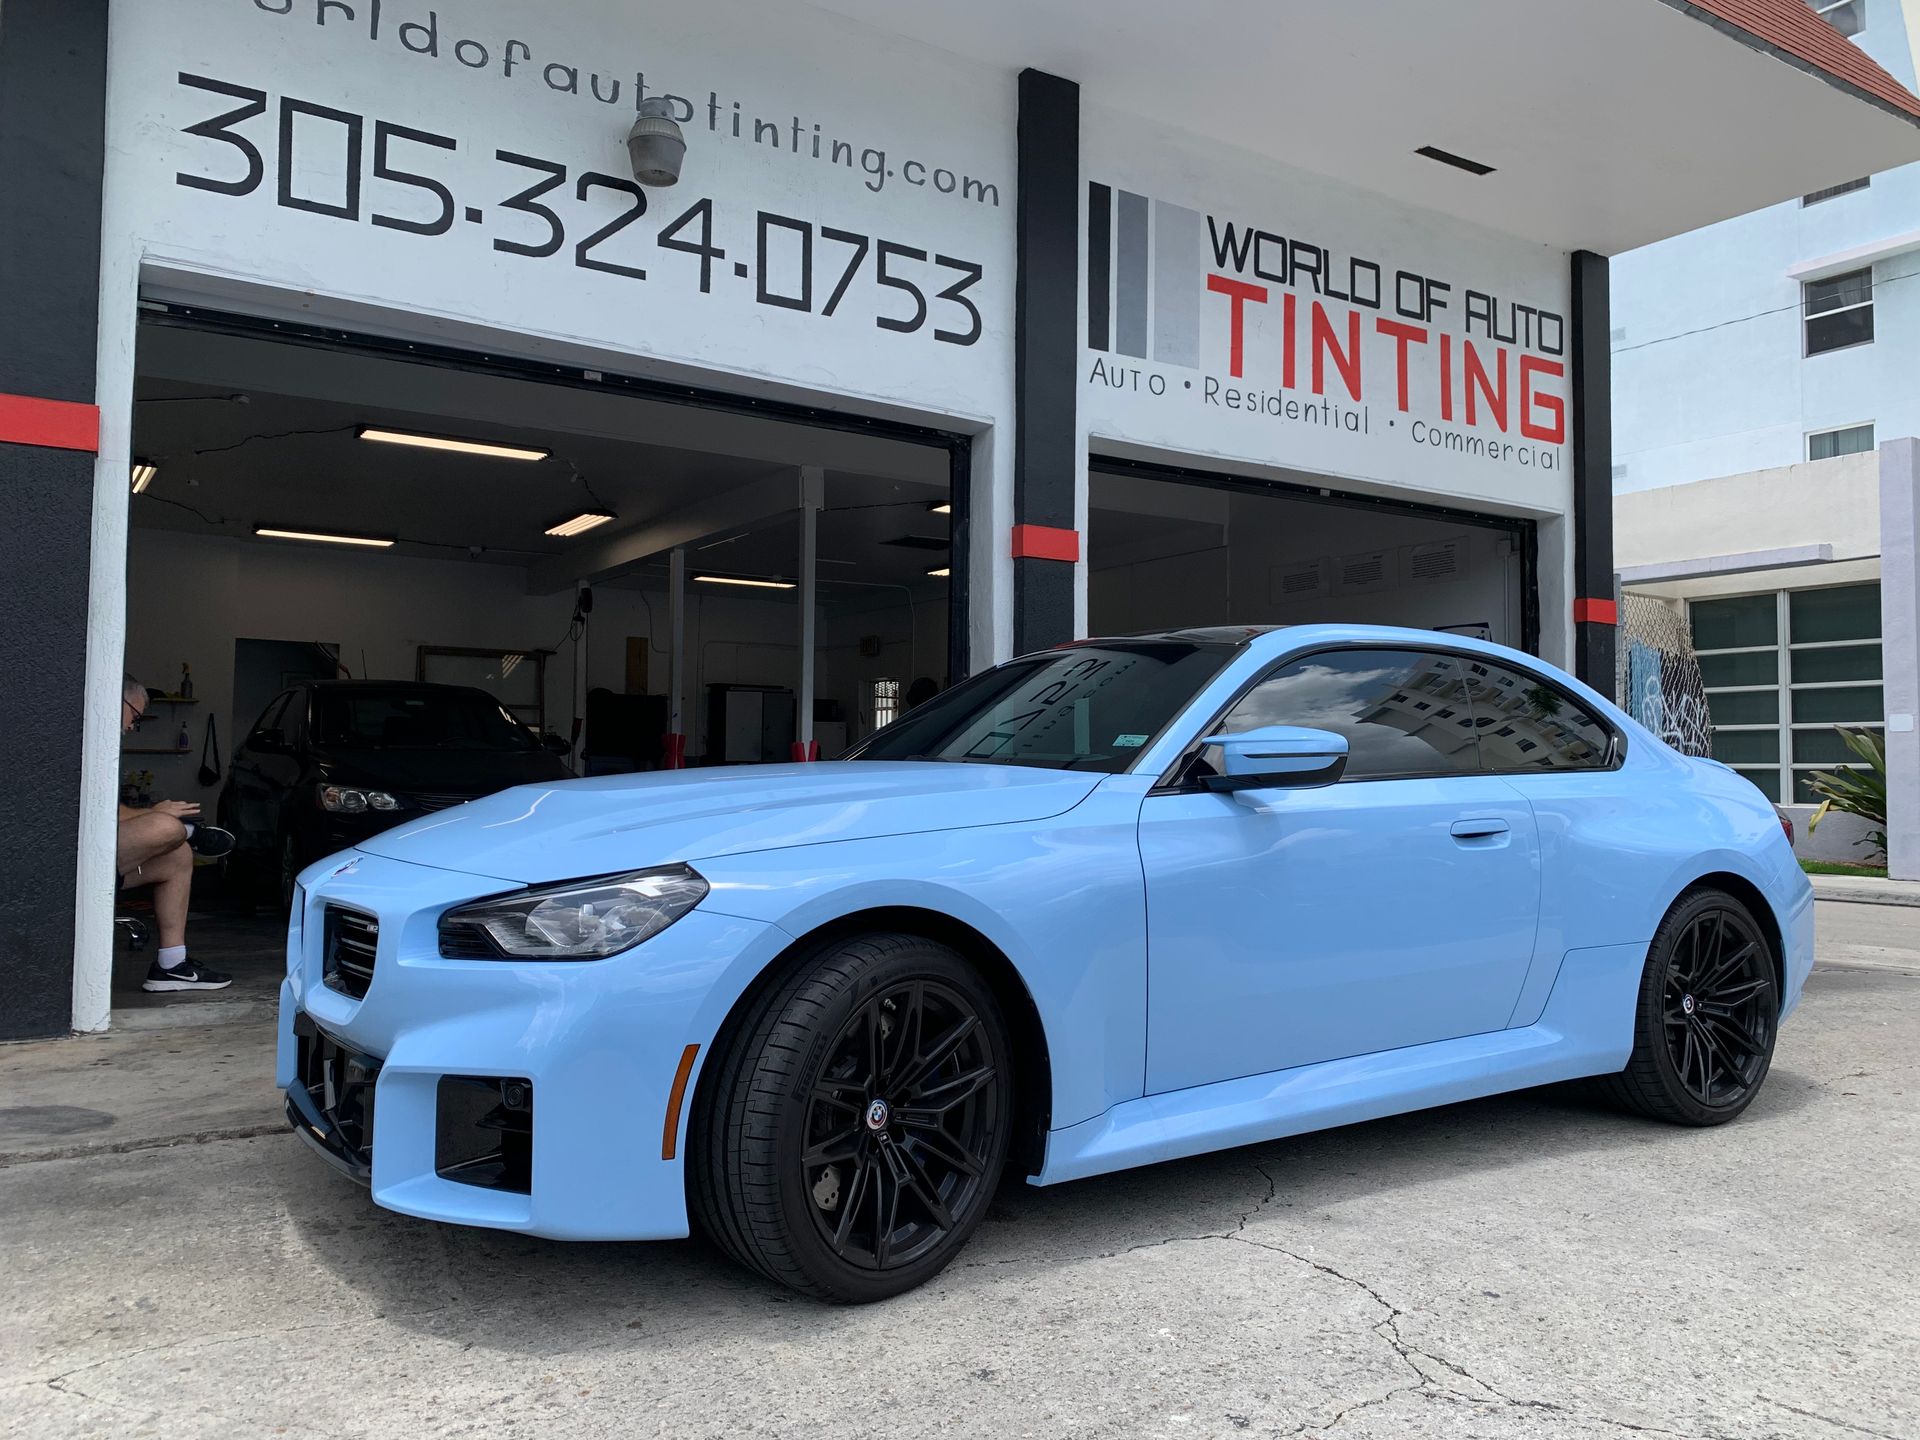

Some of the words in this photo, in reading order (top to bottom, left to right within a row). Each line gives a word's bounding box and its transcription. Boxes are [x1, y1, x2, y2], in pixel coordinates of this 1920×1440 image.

[1206, 215, 1381, 309] WORLD
[1396, 270, 1451, 323] OF
[1466, 289, 1564, 356] AUTO
[1204, 375, 1368, 435] Residential
[1411, 420, 1560, 472] Commercial
[1206, 273, 1565, 445] TINTING
